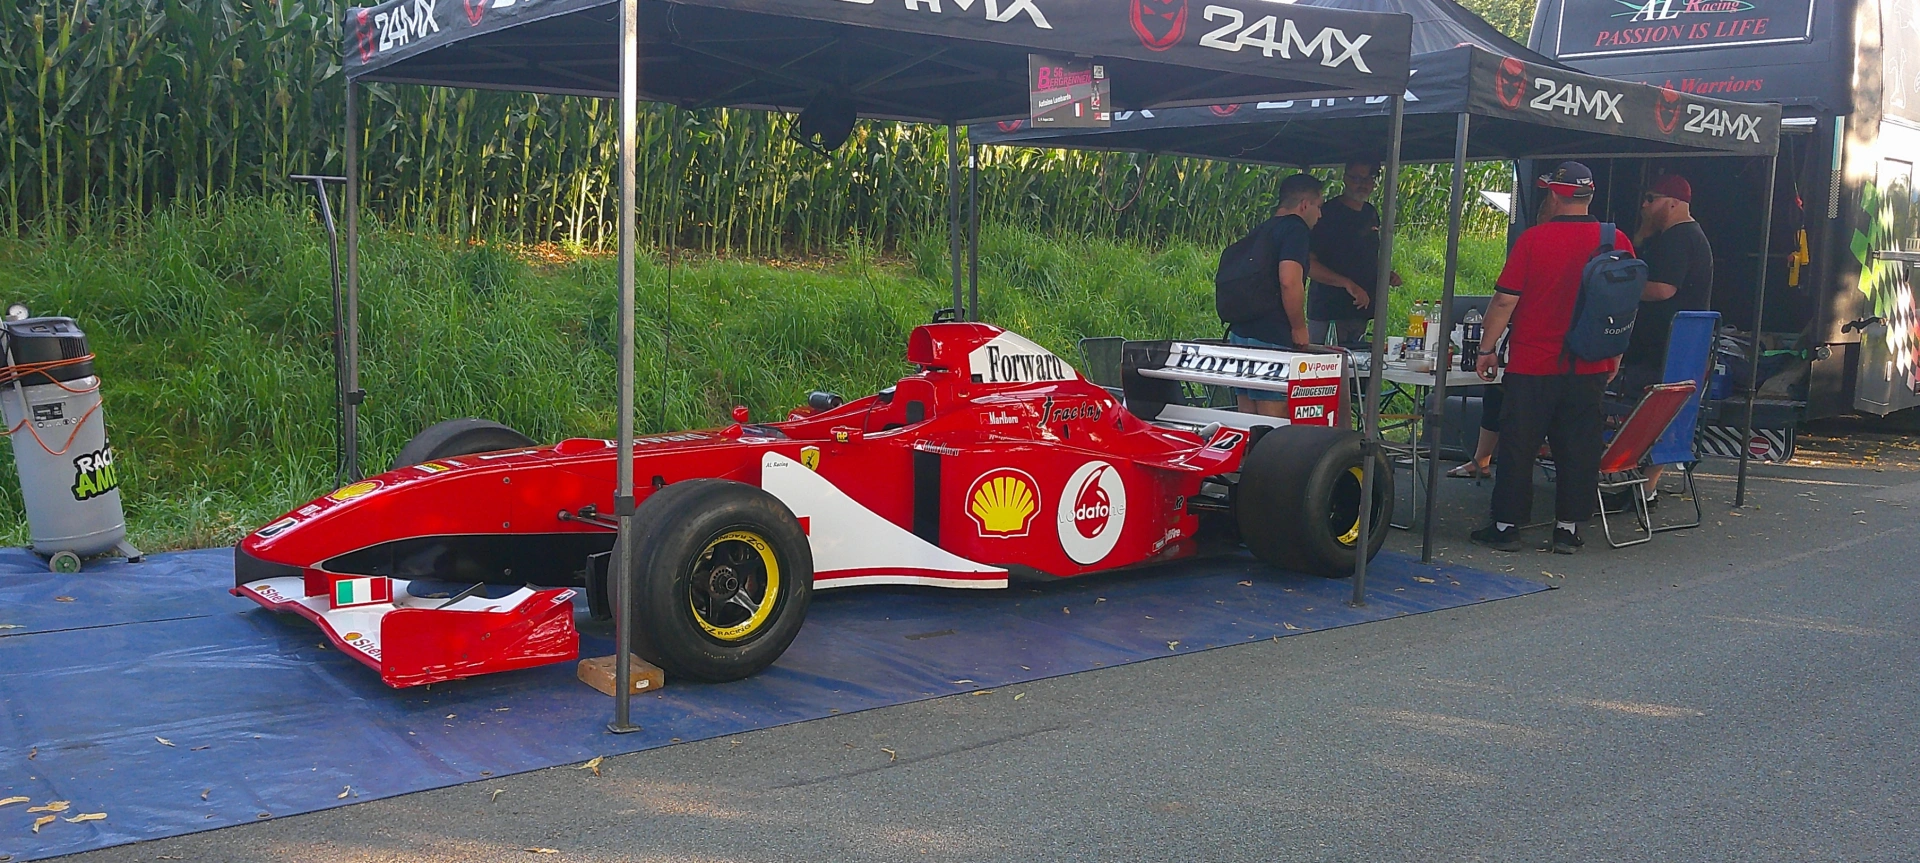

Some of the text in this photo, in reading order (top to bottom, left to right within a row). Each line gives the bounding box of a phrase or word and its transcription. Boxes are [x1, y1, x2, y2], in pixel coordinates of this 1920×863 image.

[1685, 0, 1740, 13] Racing
[374, 0, 440, 52] 24MX
[1199, 5, 1373, 73] 24MX
[1594, 18, 1770, 47] PASSION IS LIFE
[1680, 76, 1764, 94] Warriors
[1529, 78, 1625, 124] 24MX
[1684, 104, 1761, 143] 24MX
[986, 345, 1066, 383] Forward
[1176, 344, 1290, 382] Forwa
[1292, 386, 1337, 398] BRIDGESTONE
[989, 411, 1019, 425] Marlboro
[1296, 407, 1316, 418] AMD
[1058, 503, 1126, 524] vodafone
